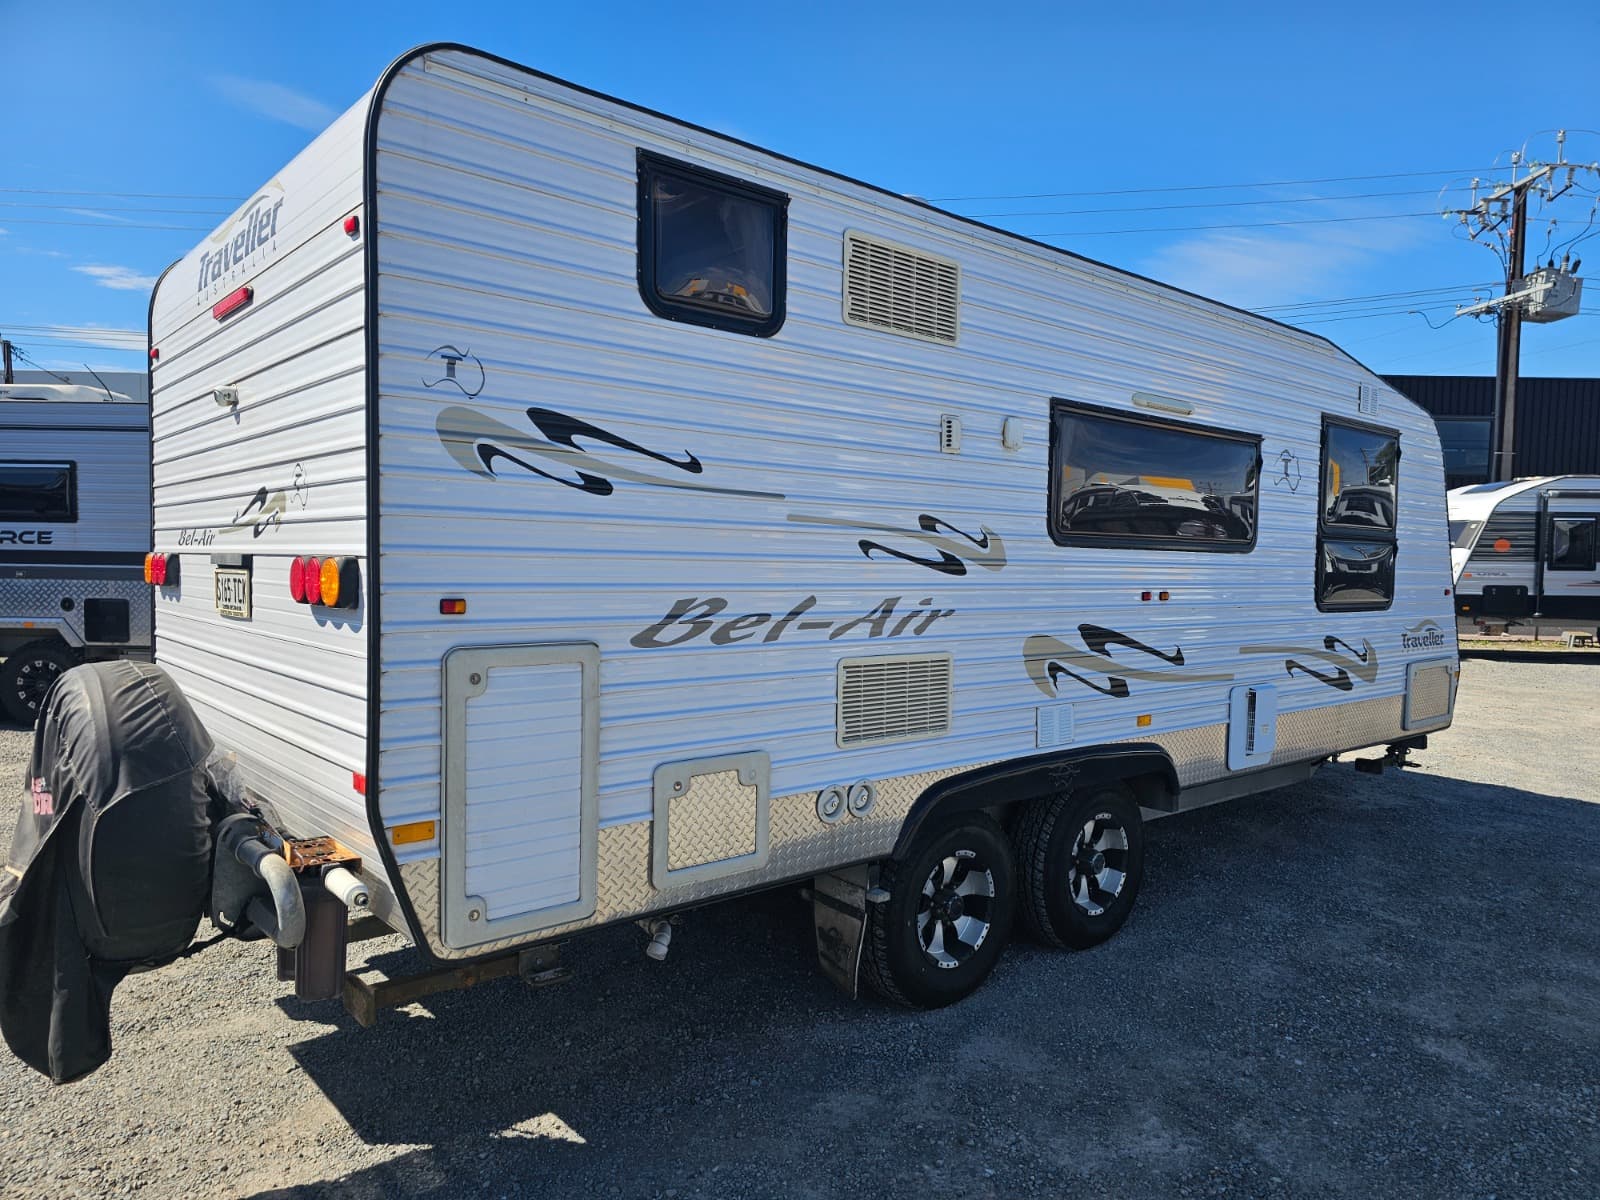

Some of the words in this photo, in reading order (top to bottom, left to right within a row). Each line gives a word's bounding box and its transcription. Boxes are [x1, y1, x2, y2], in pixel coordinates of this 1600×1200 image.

[198, 196, 284, 292] Traveller
[178, 528, 215, 546] Bel-Air
[629, 595, 956, 648] Bel-Air
[1401, 632, 1445, 649] Traveller
